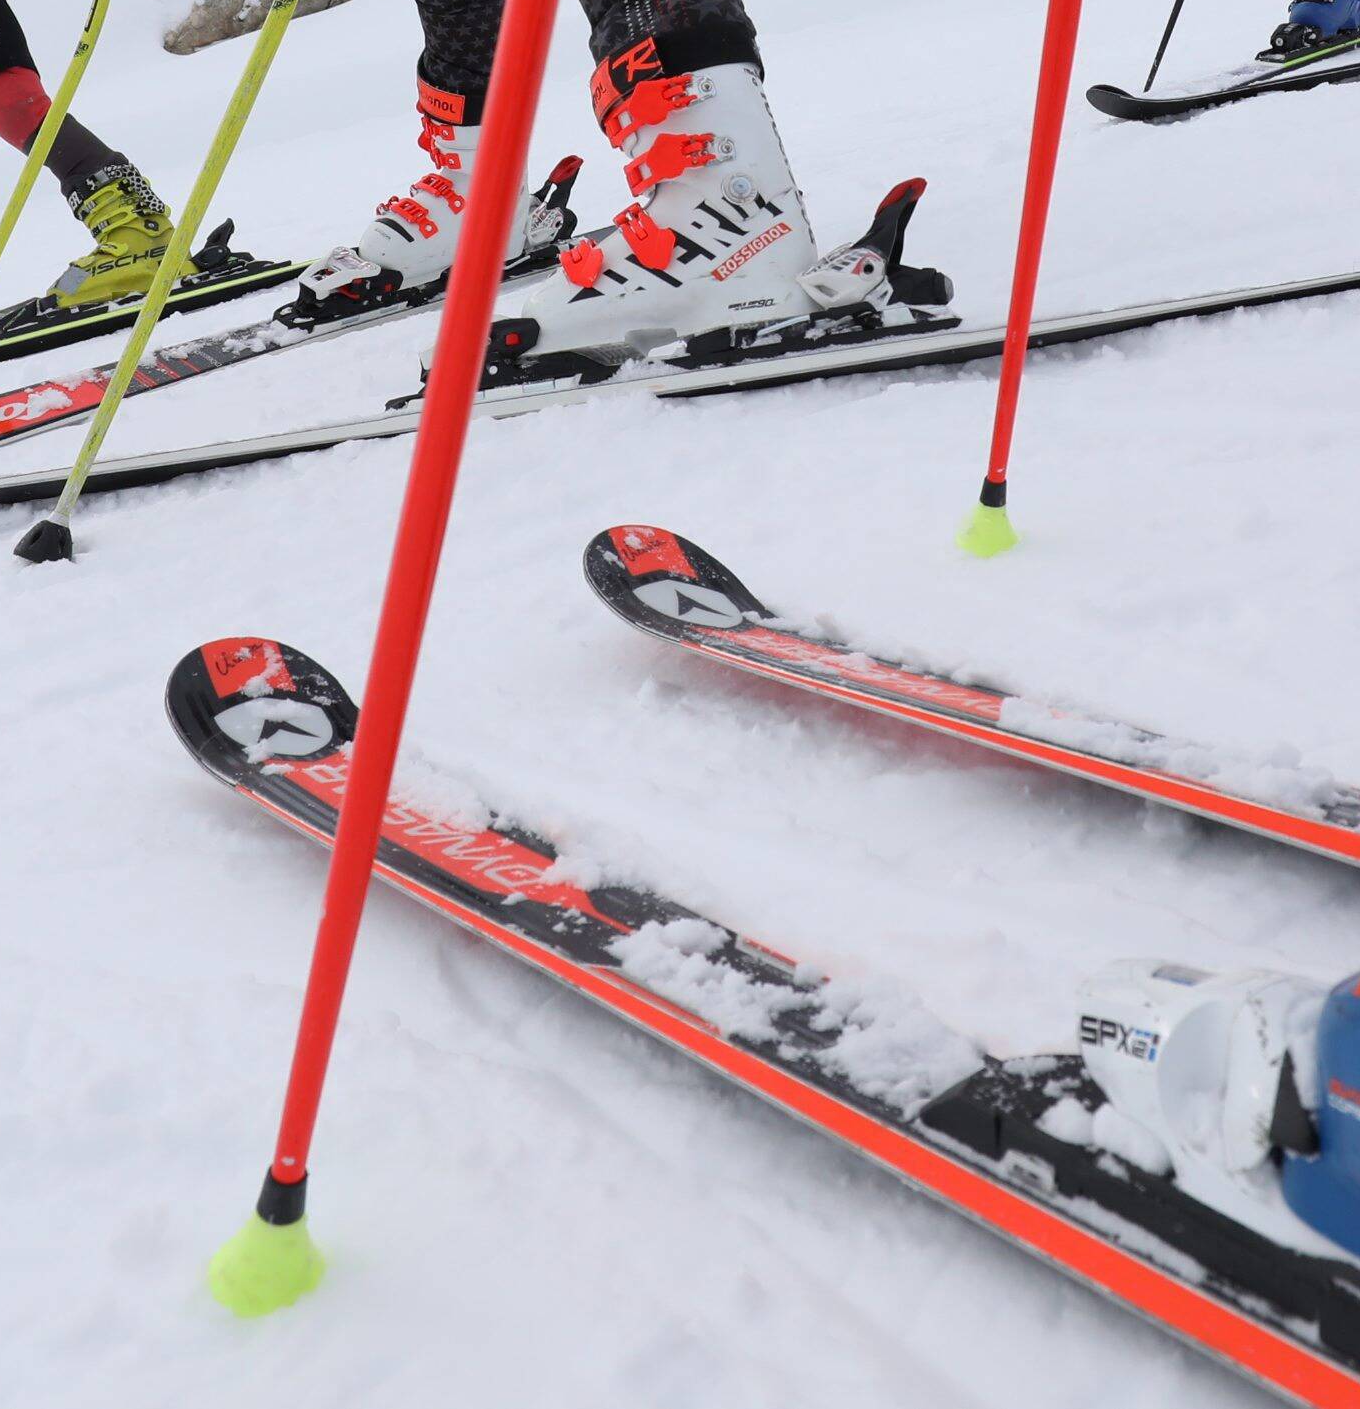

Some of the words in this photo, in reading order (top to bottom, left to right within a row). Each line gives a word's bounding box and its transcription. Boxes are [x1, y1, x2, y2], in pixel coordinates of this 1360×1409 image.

[85, 244, 170, 278] ISCHE
[719, 224, 791, 280] ROSSIGNOL
[301, 762, 546, 890] DYNASR
